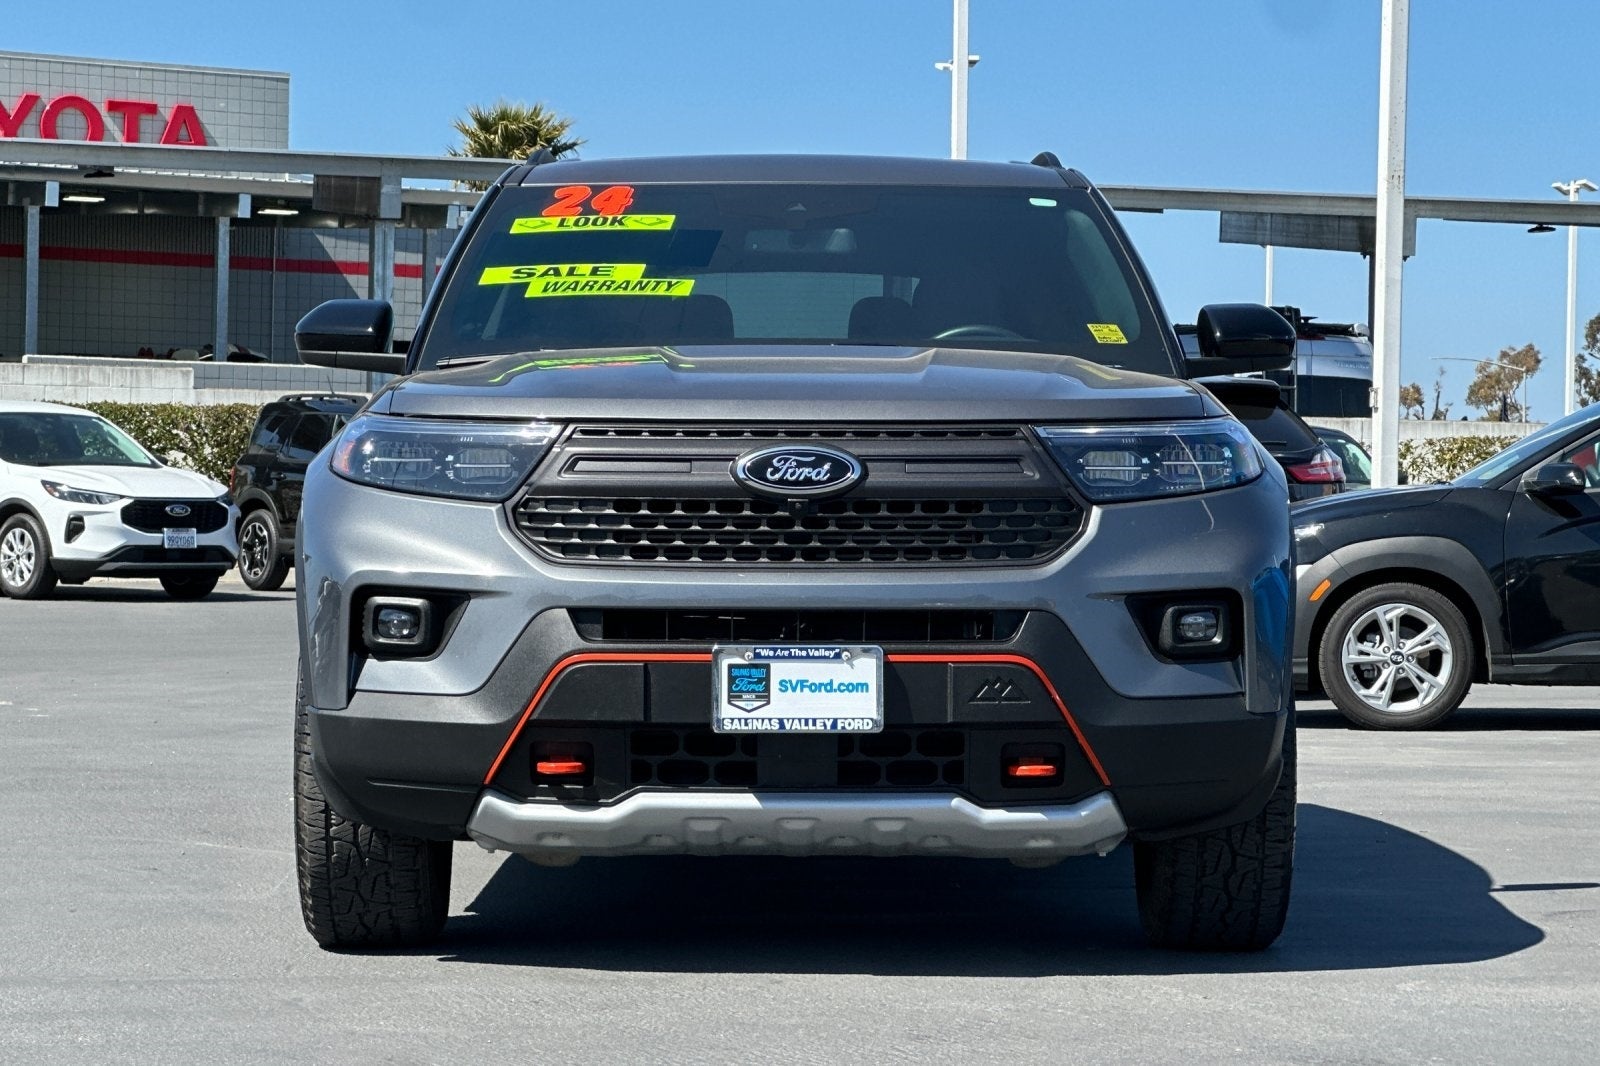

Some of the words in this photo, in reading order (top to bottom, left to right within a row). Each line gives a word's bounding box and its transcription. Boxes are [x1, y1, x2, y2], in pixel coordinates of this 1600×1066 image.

[0, 93, 208, 147] YOTA
[541, 185, 635, 217] 24
[557, 215, 630, 229] LOOK
[509, 265, 615, 280] SALE
[541, 279, 681, 294] WARRANTY
[766, 455, 832, 481] Ford
[775, 649, 790, 657] Are
[791, 649, 807, 657] The
[732, 677, 766, 692] Ford
[778, 678, 869, 693] SVFord.com
[723, 718, 780, 731] SALINAS
[782, 718, 833, 731] VALLEY
[837, 718, 873, 731] FORD
